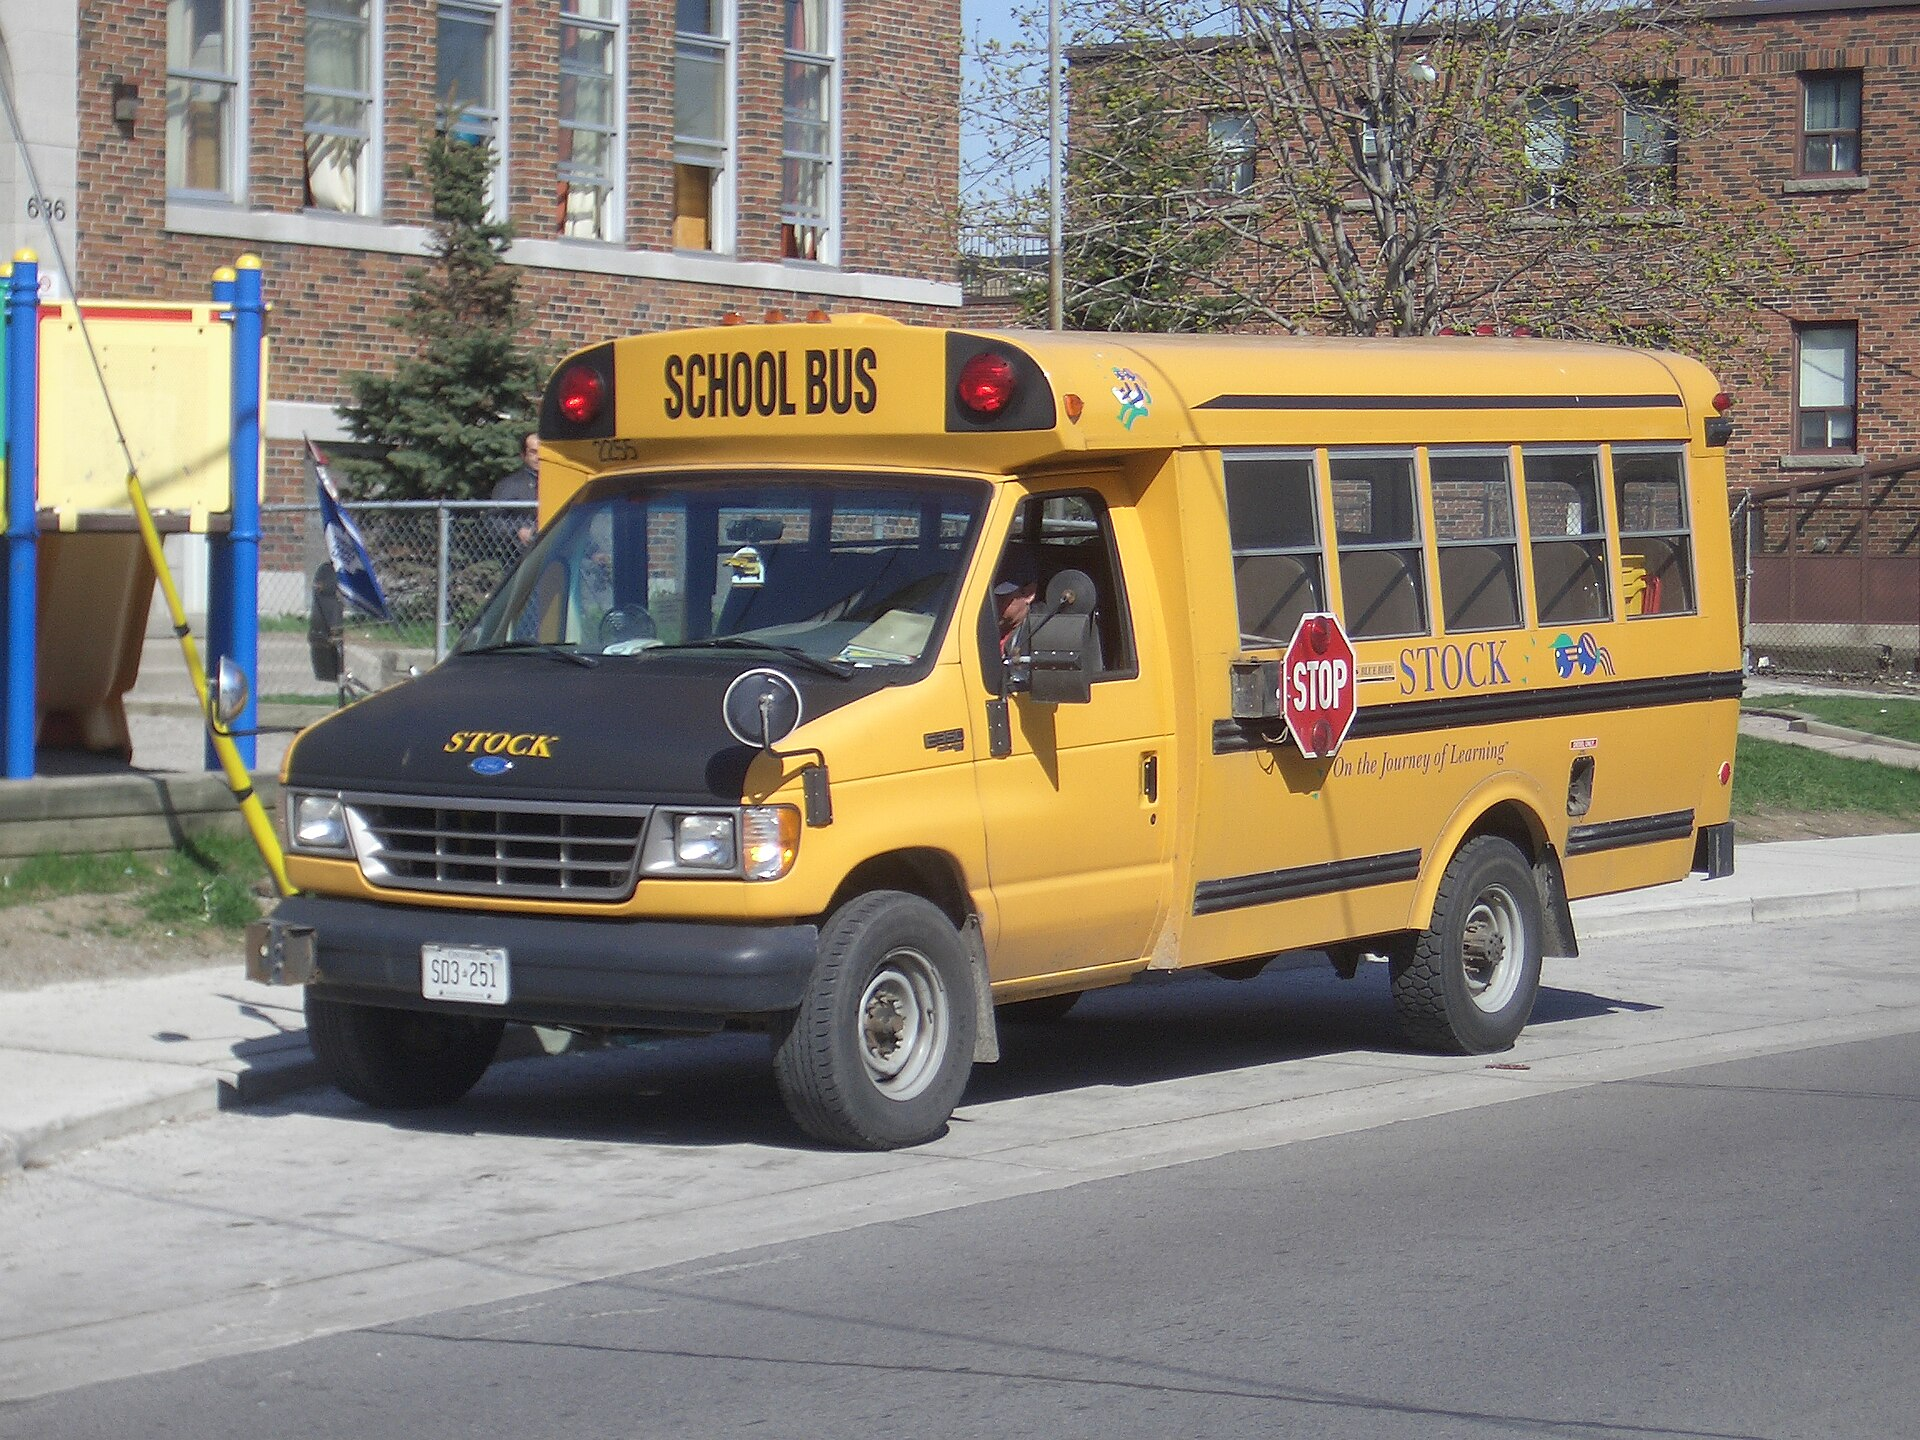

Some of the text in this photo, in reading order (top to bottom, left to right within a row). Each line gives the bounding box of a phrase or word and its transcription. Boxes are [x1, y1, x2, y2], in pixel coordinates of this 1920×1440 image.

[663, 346, 878, 420] SCHOOL BUS
[1293, 659, 1348, 712] STOP
[1399, 639, 1511, 696] STOCK
[443, 730, 560, 759] STOCK
[1333, 740, 1508, 780] On the Journey of Learning
